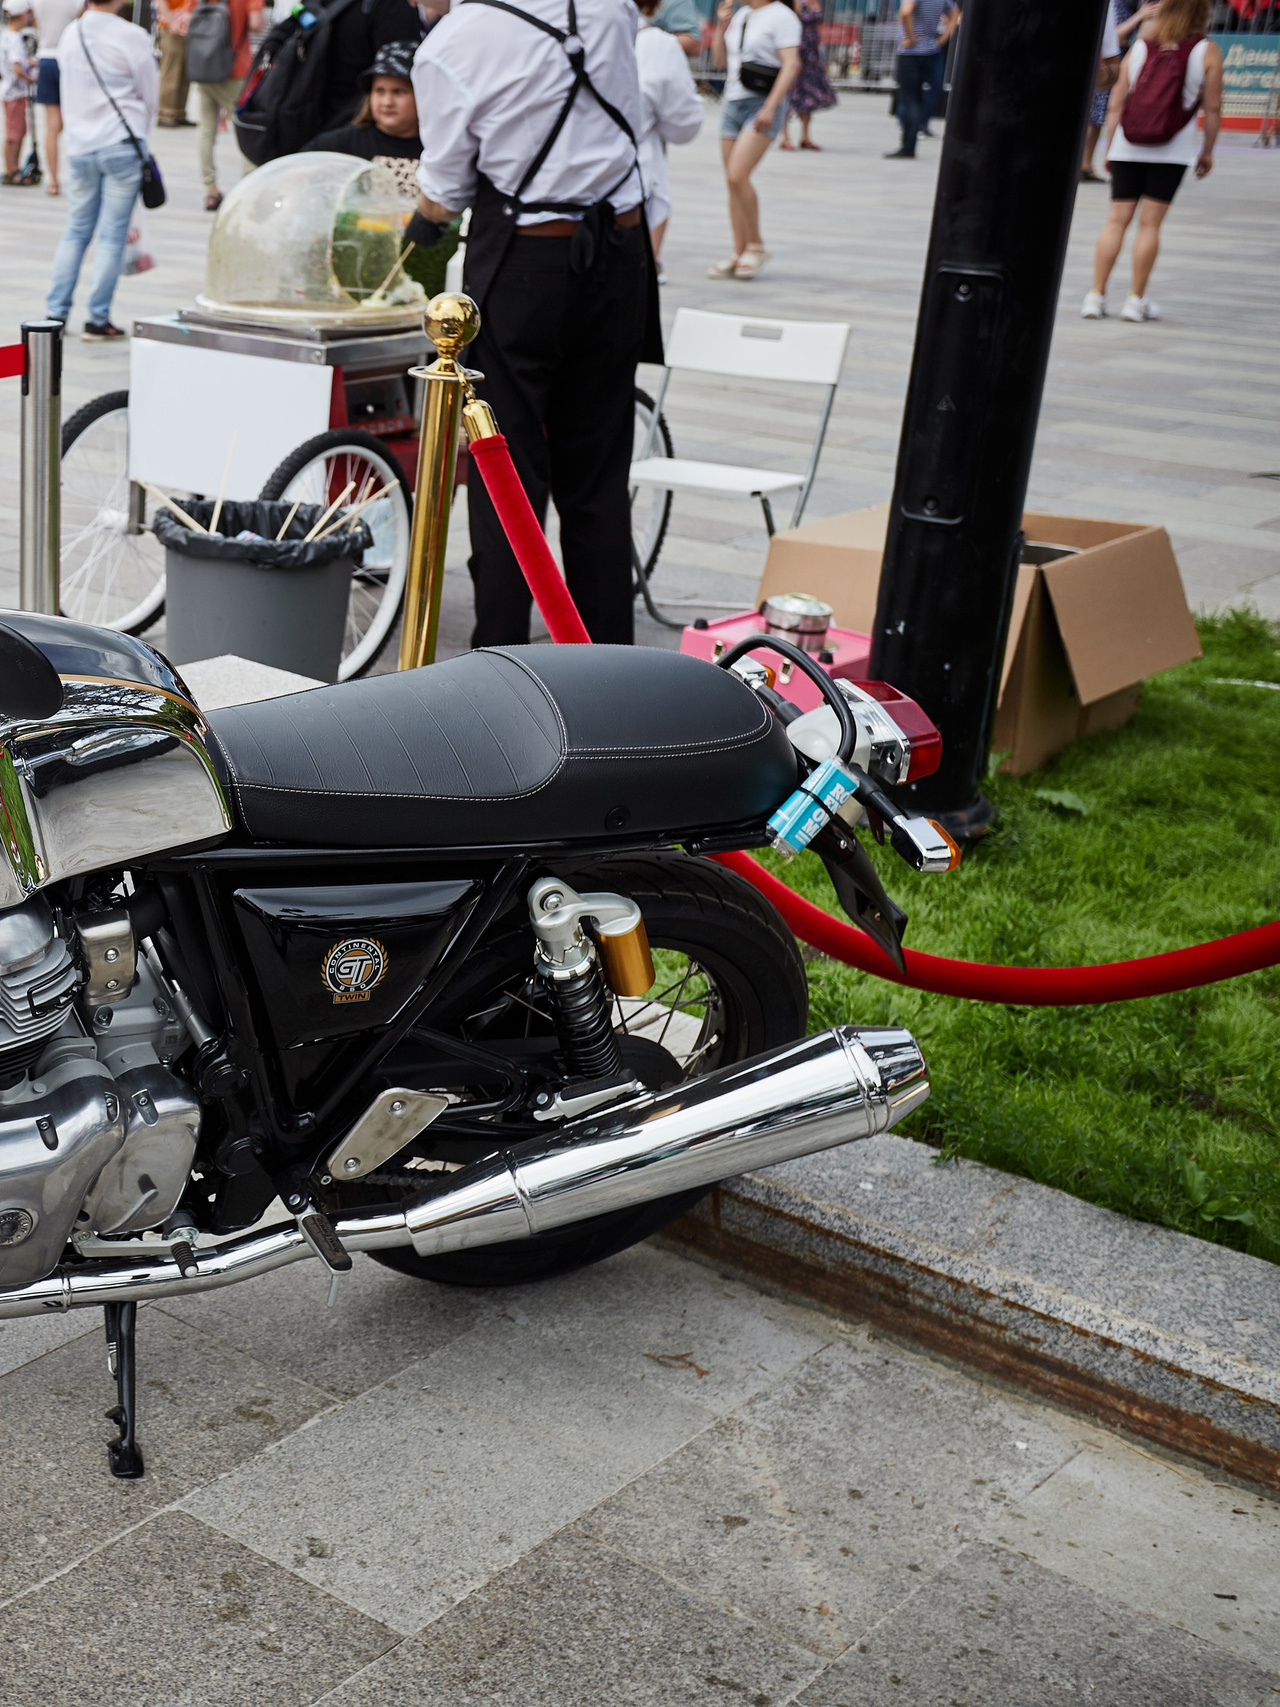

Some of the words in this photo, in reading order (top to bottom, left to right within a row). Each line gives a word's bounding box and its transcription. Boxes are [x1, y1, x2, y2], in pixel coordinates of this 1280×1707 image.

[329, 942, 380, 974] CONTINENTAL
[337, 955, 372, 985] GT
[338, 993, 366, 1001] TWIN
[339, 983, 366, 992] 650
